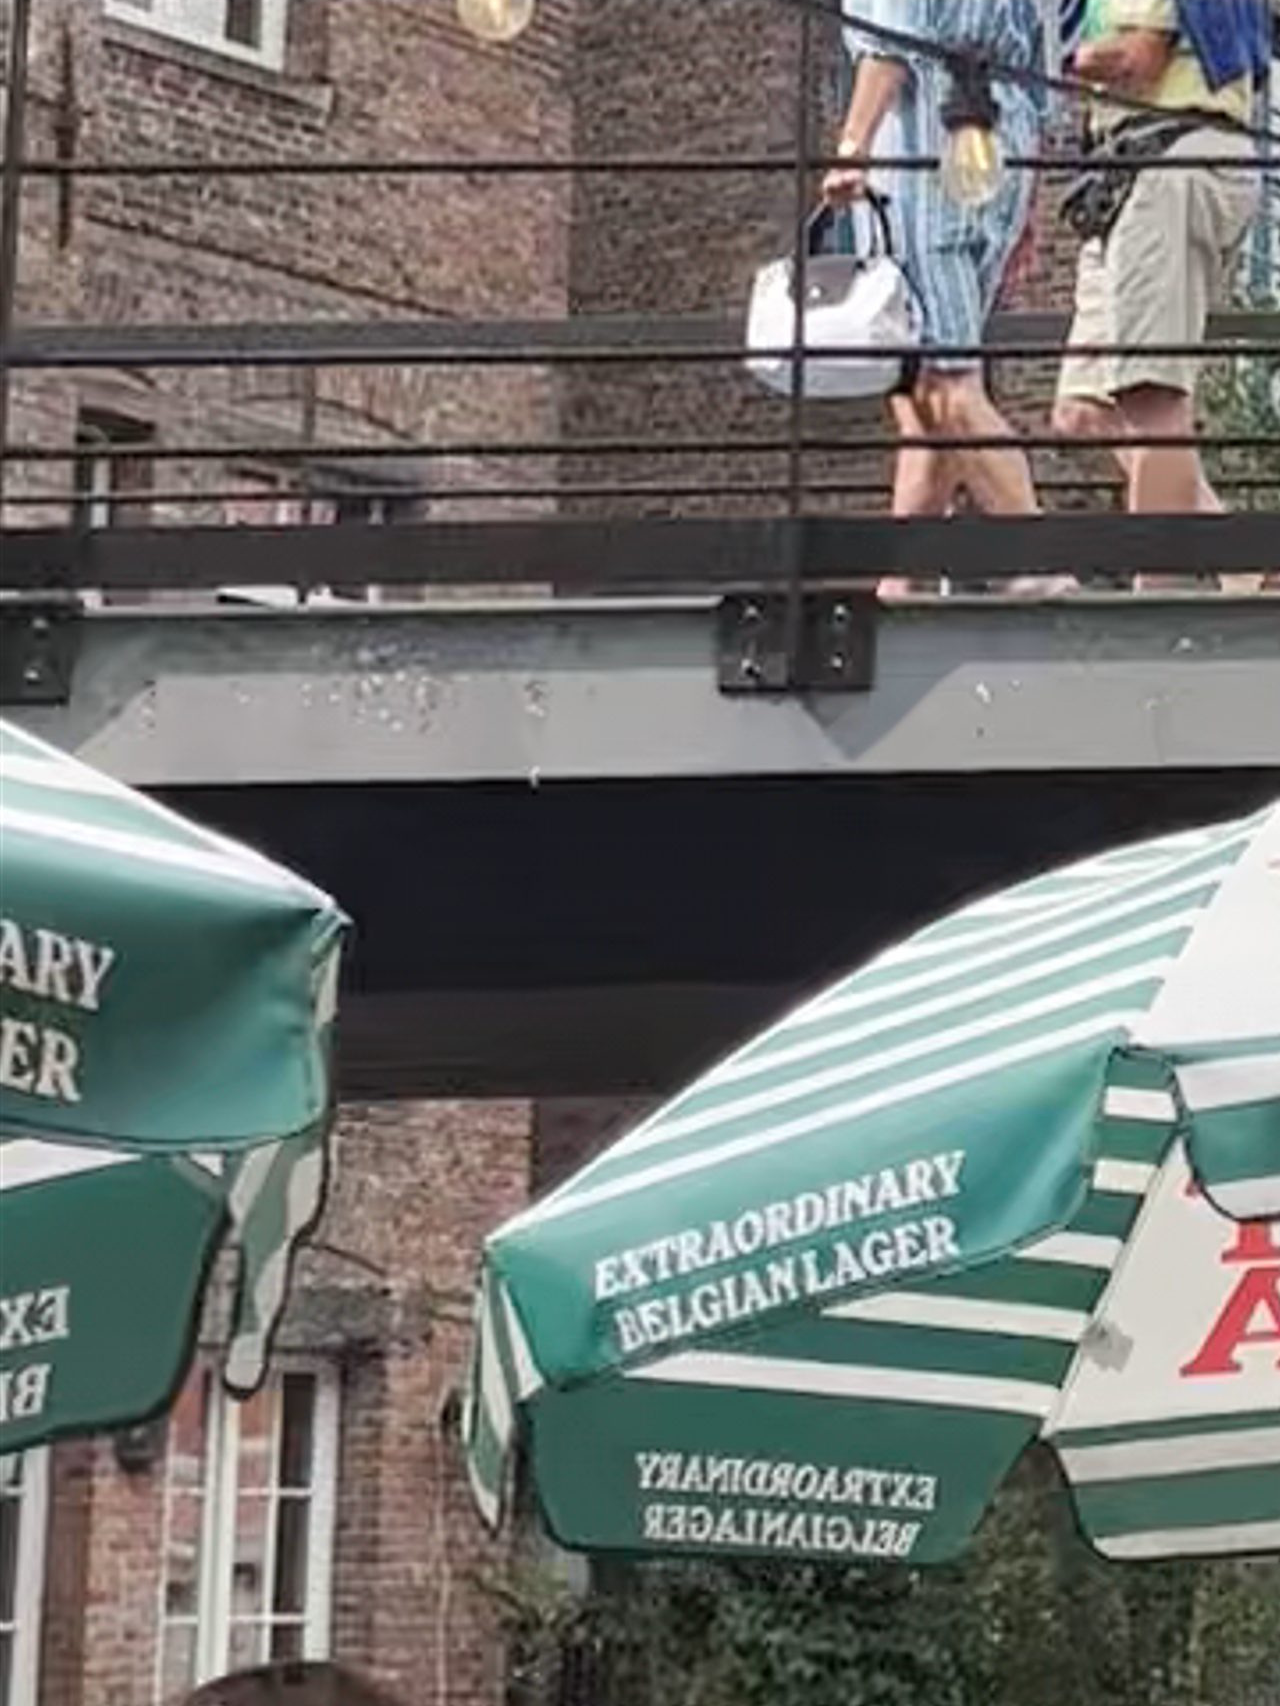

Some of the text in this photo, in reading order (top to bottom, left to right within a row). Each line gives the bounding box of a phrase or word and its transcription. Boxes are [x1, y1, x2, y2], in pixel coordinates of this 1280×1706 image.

[593, 1149, 966, 1300] EXTRAORDINARY
[614, 1216, 961, 1352] BELGIAN LAGER
